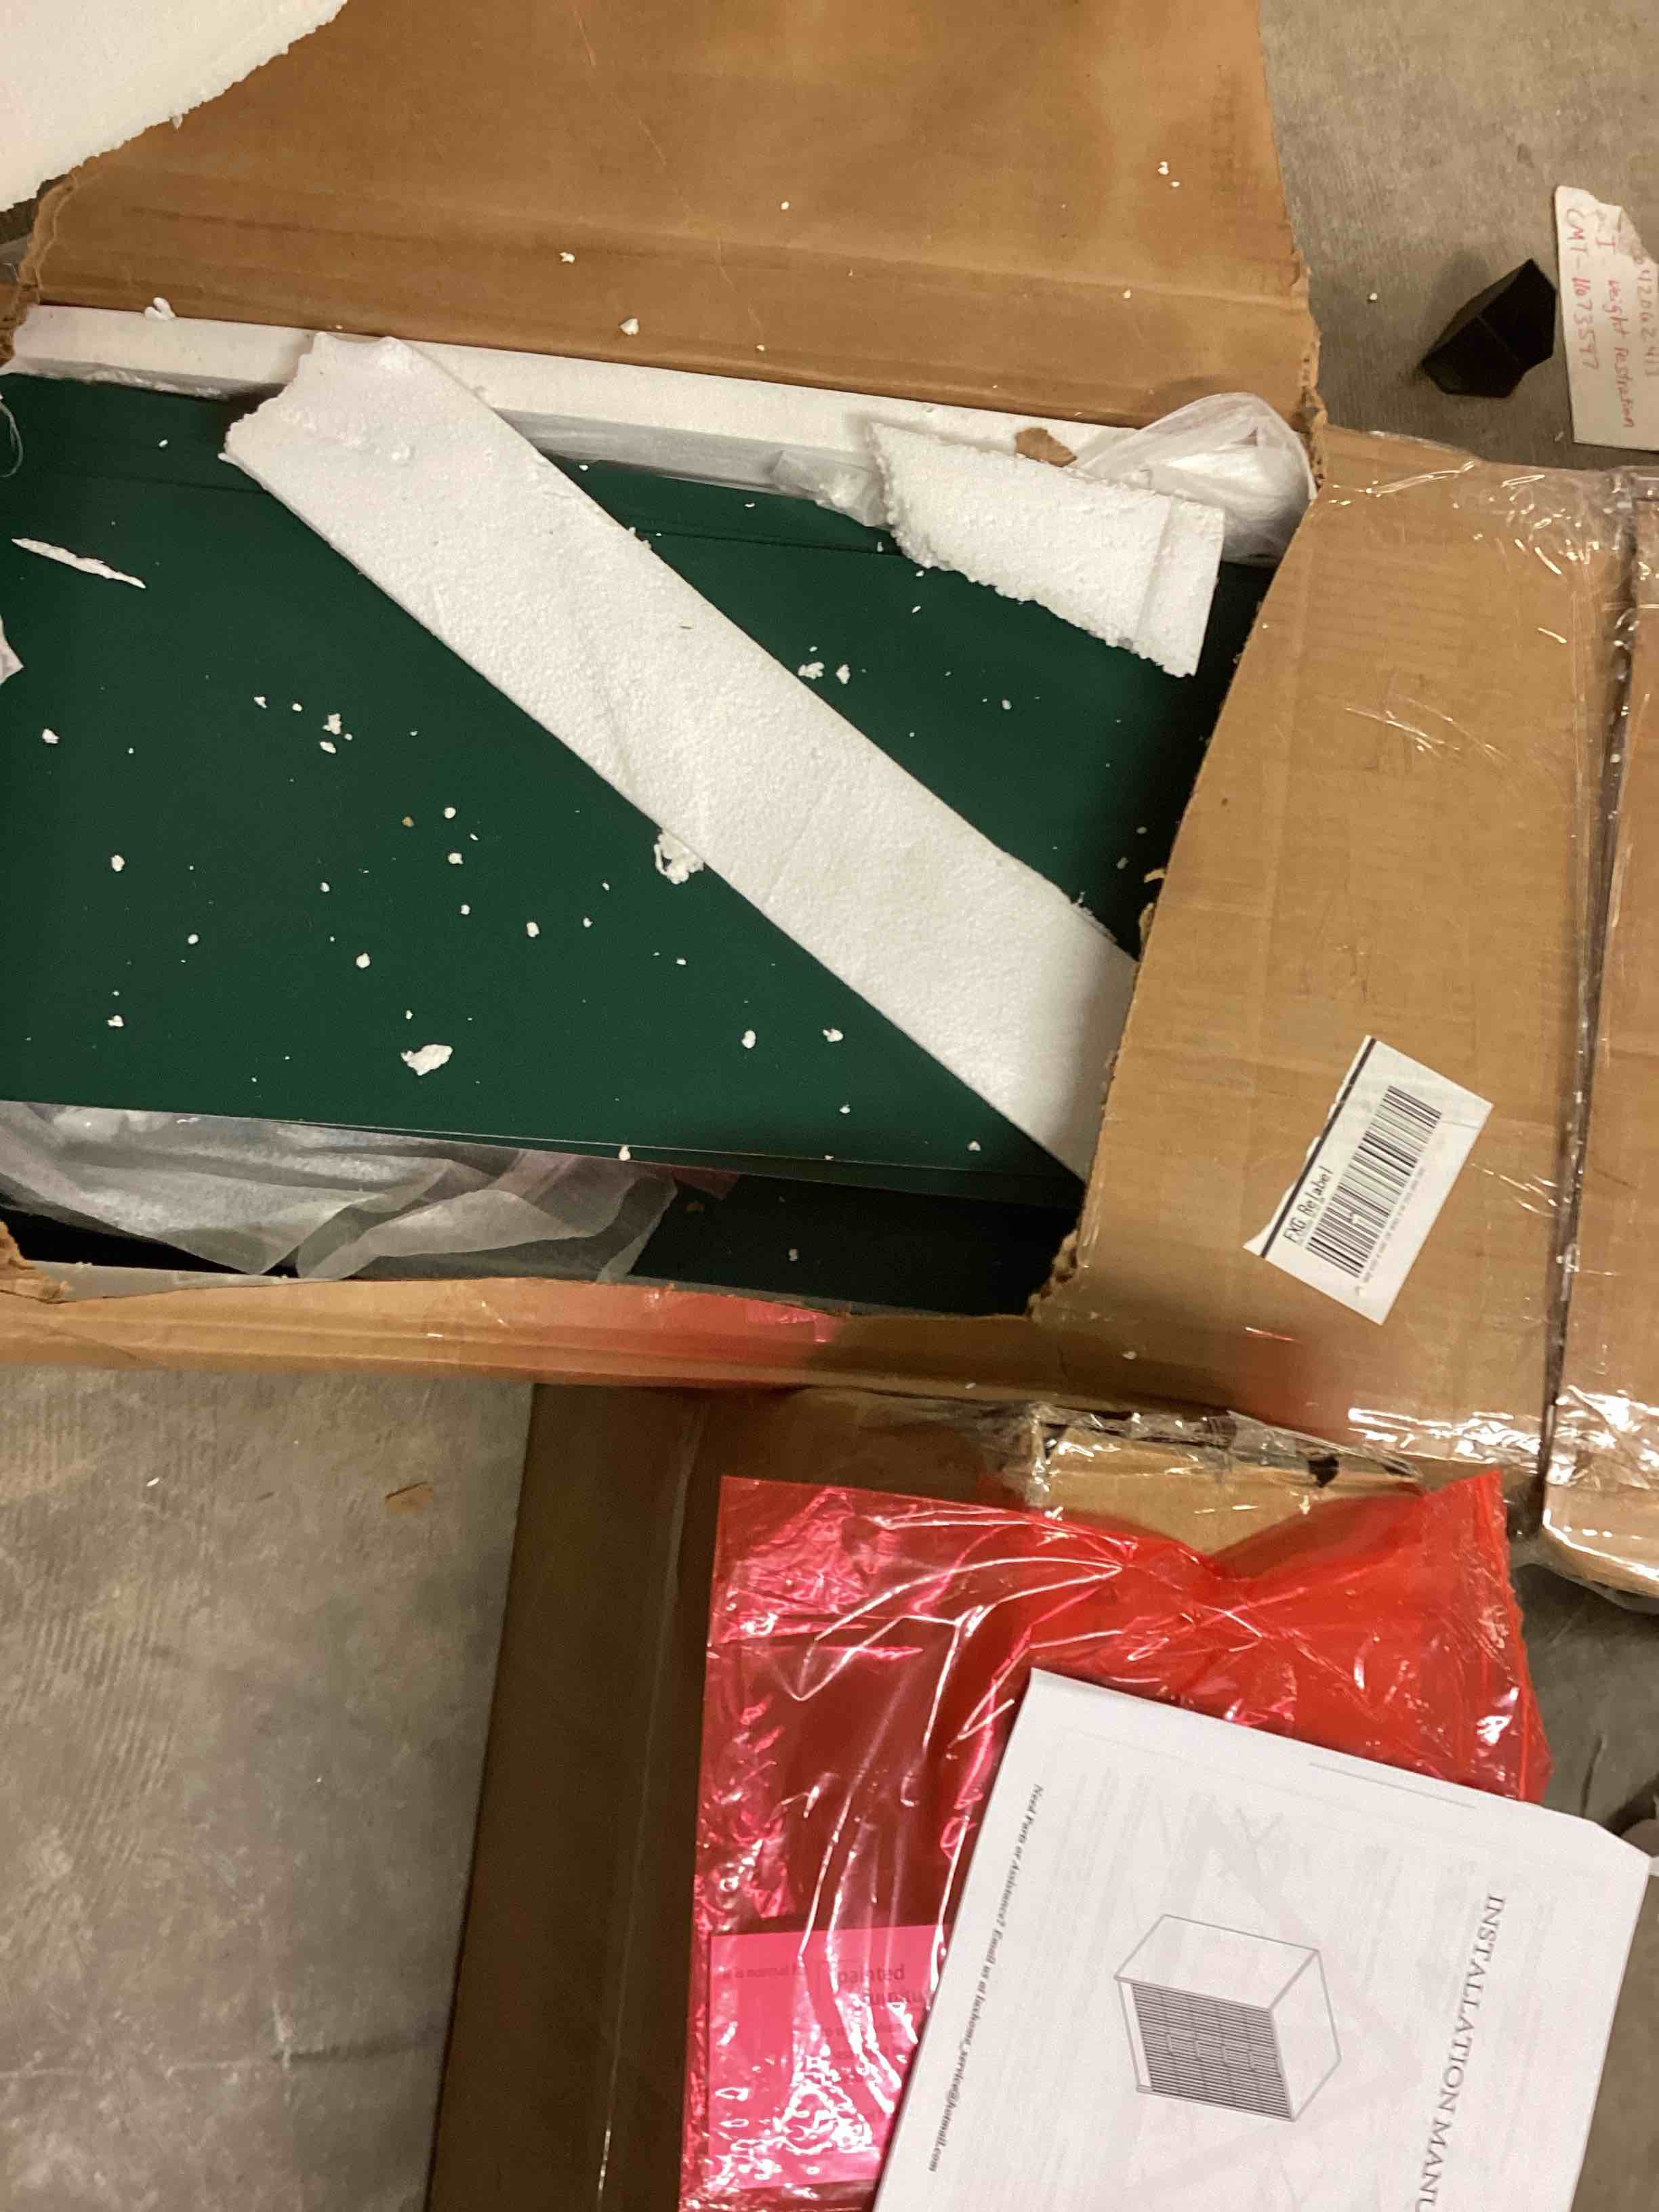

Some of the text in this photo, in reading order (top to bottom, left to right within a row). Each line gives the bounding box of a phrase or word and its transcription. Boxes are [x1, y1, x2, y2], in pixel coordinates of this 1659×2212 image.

[1283, 1165, 1333, 1244] FXG Relabel
[1027, 1783, 1044, 1814] Need
[1018, 1814, 1034, 1843] Parts
[1014, 1845, 1023, 1860] or
[996, 1859, 1019, 1927] Assistance?
[985, 1928, 1002, 1964] Email
[1437, 1894, 1507, 2114] INSTALLATION
